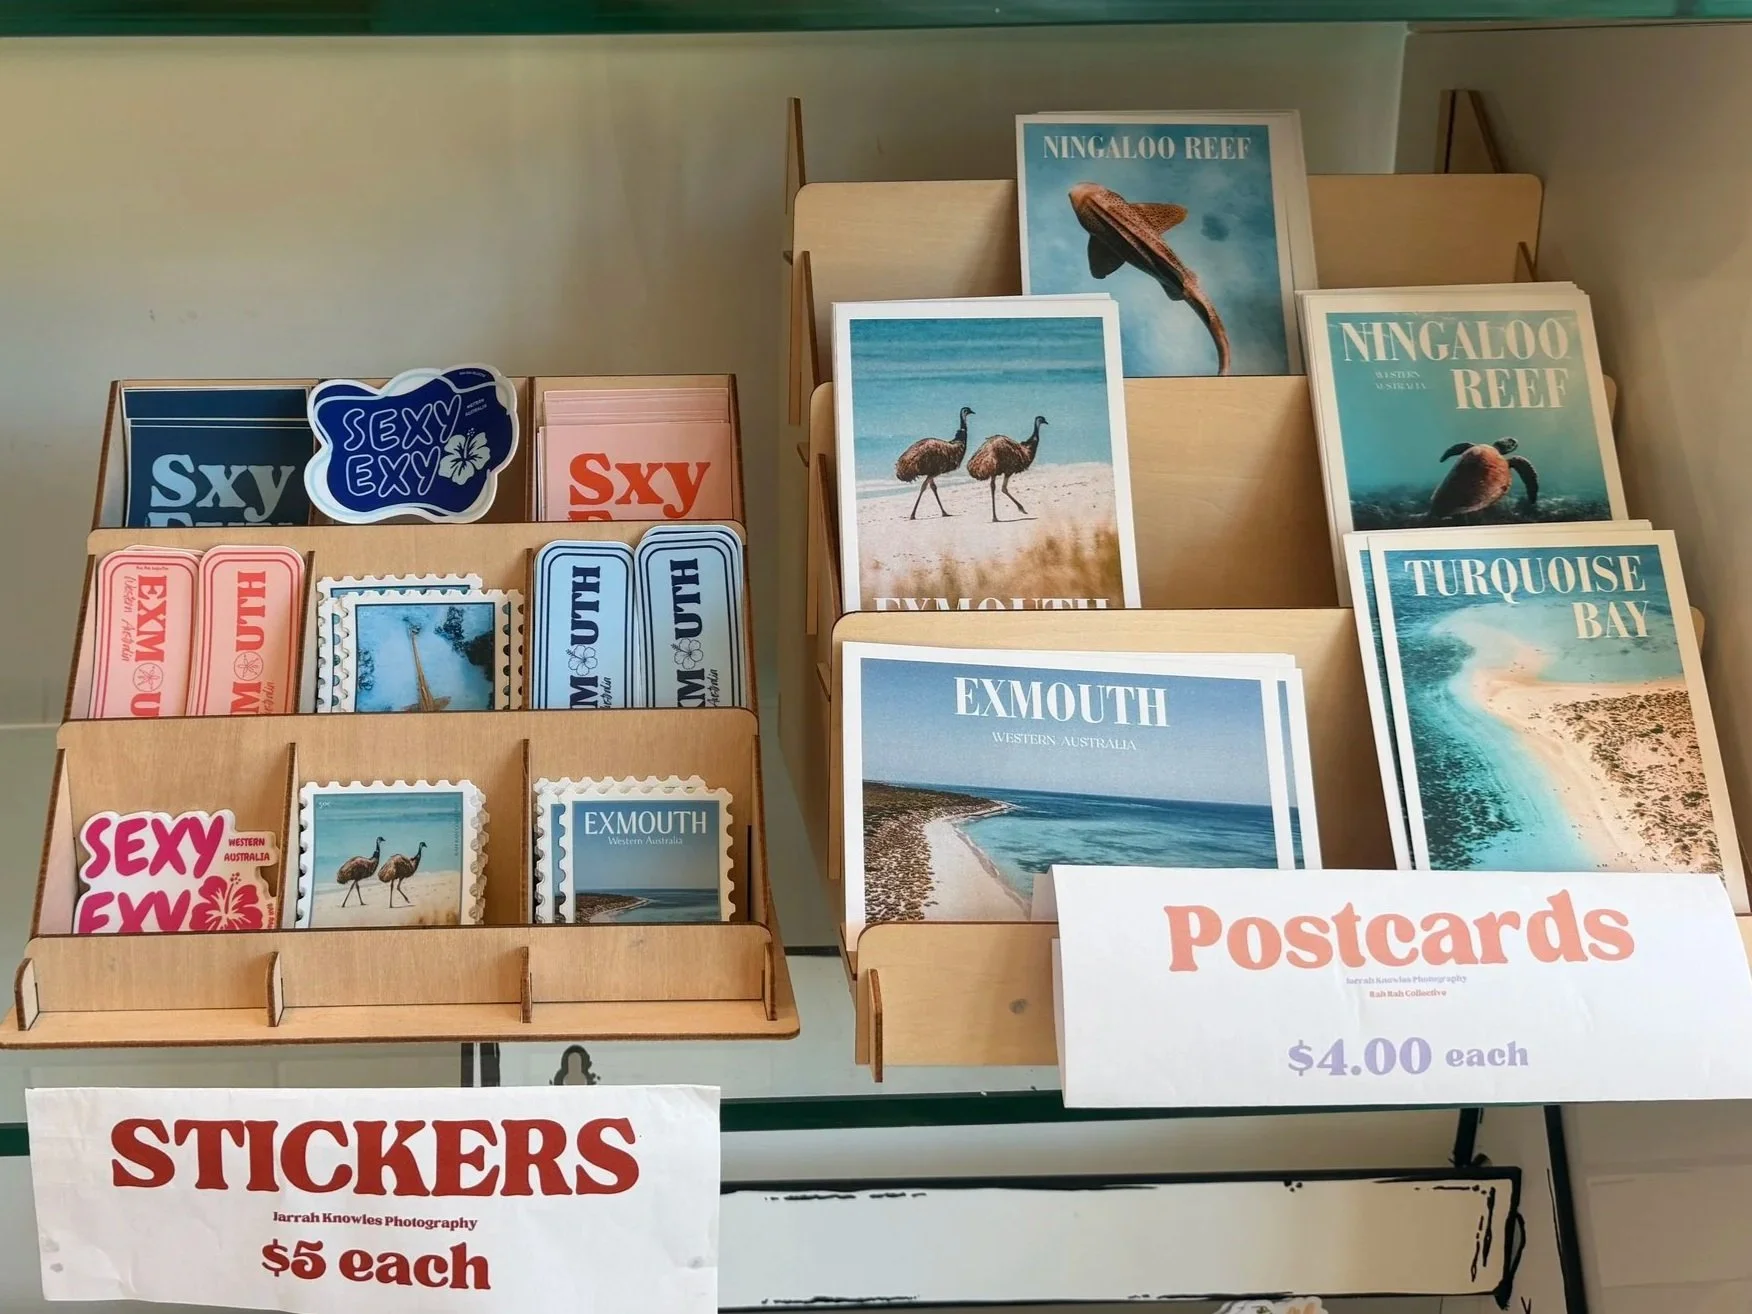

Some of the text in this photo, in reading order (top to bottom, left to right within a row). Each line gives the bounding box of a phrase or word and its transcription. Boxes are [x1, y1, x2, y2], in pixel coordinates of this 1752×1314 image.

[1043, 136, 1252, 160] NINGALOO REEF
[1338, 318, 1570, 363] NINGALOO
[1450, 367, 1570, 410] REEF
[342, 394, 462, 451] SEXY
[150, 453, 296, 523] Sxy
[345, 445, 441, 498] EXY
[569, 452, 711, 519] Sxy
[1404, 555, 1647, 605] TURQUOISE
[1571, 600, 1650, 640] BAY
[953, 676, 1171, 728] EXMOUTH
[992, 731, 1137, 751] WESTERN AUSTRALIA
[228, 837, 266, 847] WESTERN
[584, 810, 707, 835] EXMOUTH
[607, 835, 683, 845] Western Australia
[85, 815, 224, 879] SEXY
[224, 852, 270, 862] AUSTRALIA
[1163, 888, 1635, 972] Postcards
[1405, 987, 1447, 997] Collective
[1288, 1036, 1529, 1076] $4.00 each
[110, 1117, 640, 1197] STICKERS
[273, 1211, 478, 1231] Jarrah Knowles Photography
[261, 1238, 491, 1290] $5 each
